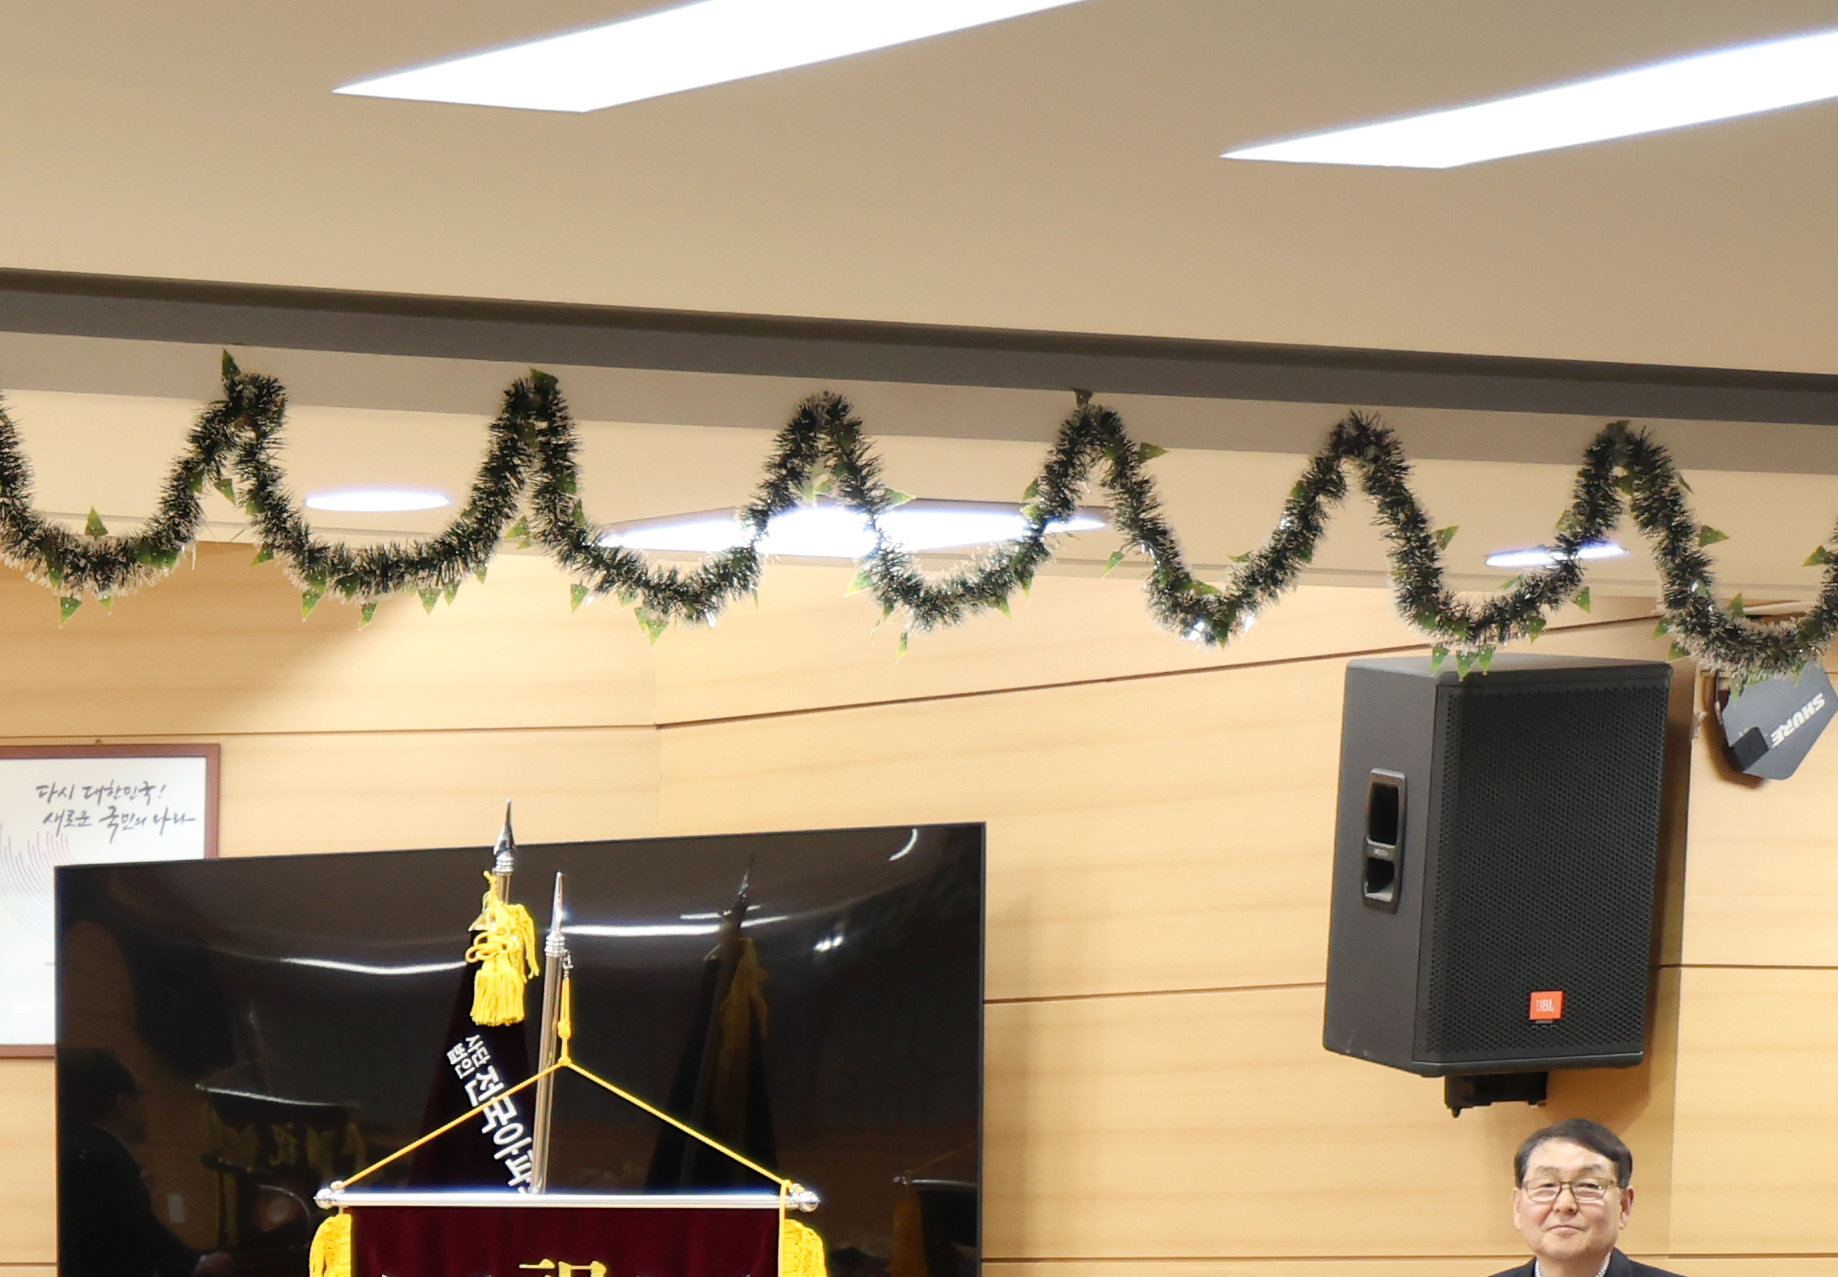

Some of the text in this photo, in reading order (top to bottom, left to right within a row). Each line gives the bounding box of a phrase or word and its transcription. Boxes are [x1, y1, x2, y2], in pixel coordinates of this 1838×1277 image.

[1770, 692, 1826, 749] SHURE
[35, 779, 167, 807] 다시 대한민국!
[41, 804, 197, 845] 새로운 국민의 나라
[1535, 998, 1555, 1012] JBL
[446, 1042, 476, 1080] 법인
[465, 1034, 491, 1069] 사단
